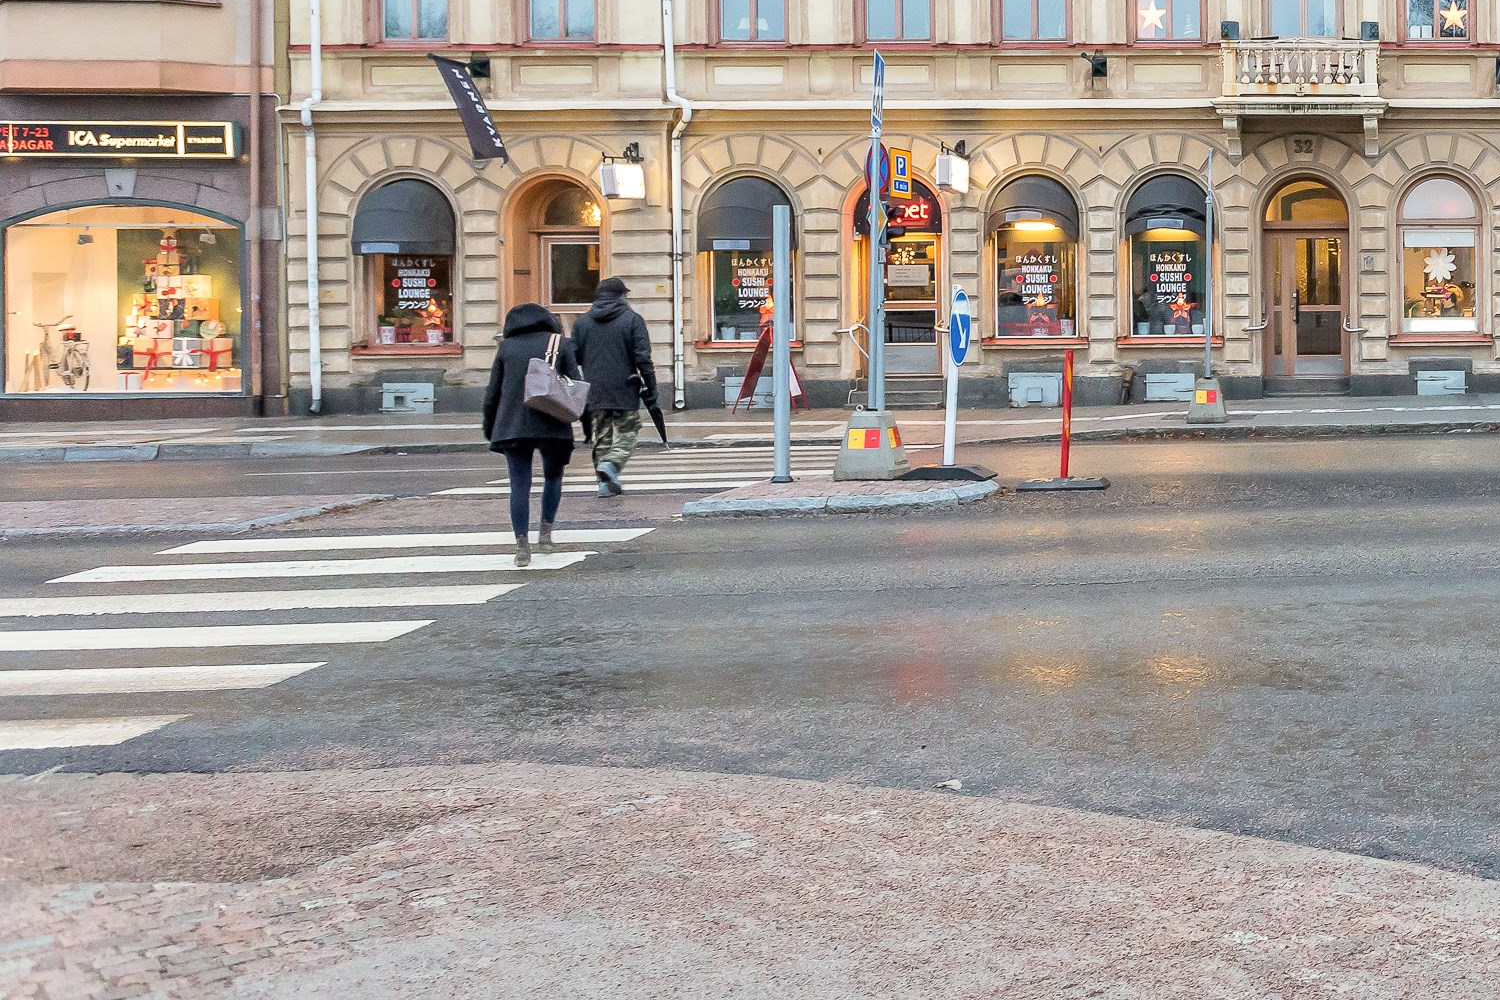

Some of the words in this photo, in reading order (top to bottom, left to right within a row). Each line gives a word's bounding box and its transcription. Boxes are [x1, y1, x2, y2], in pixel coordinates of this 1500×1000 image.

[451, 68, 504, 148] KVARNEN
[67, 130, 98, 146] ICA
[99, 133, 176, 148] Supermarket
[12, 140, 54, 150] DAGAR
[1293, 139, 1313, 153] 32
[897, 157, 905, 175] P
[398, 269, 431, 277] HONKAKU
[737, 268, 769, 276] HONKAKU
[1021, 265, 1053, 273] HONKAKU
[1025, 274, 1049, 283] SUSHI
[1159, 273, 1183, 282] SUSHI
[402, 278, 427, 287] SUSHI
[741, 278, 765, 287] SUSHI
[1022, 285, 1053, 294] LOUNGE
[1156, 283, 1187, 292] LOUNGE
[398, 289, 431, 298] LOUNGE
[738, 288, 769, 297] LOUNGE
